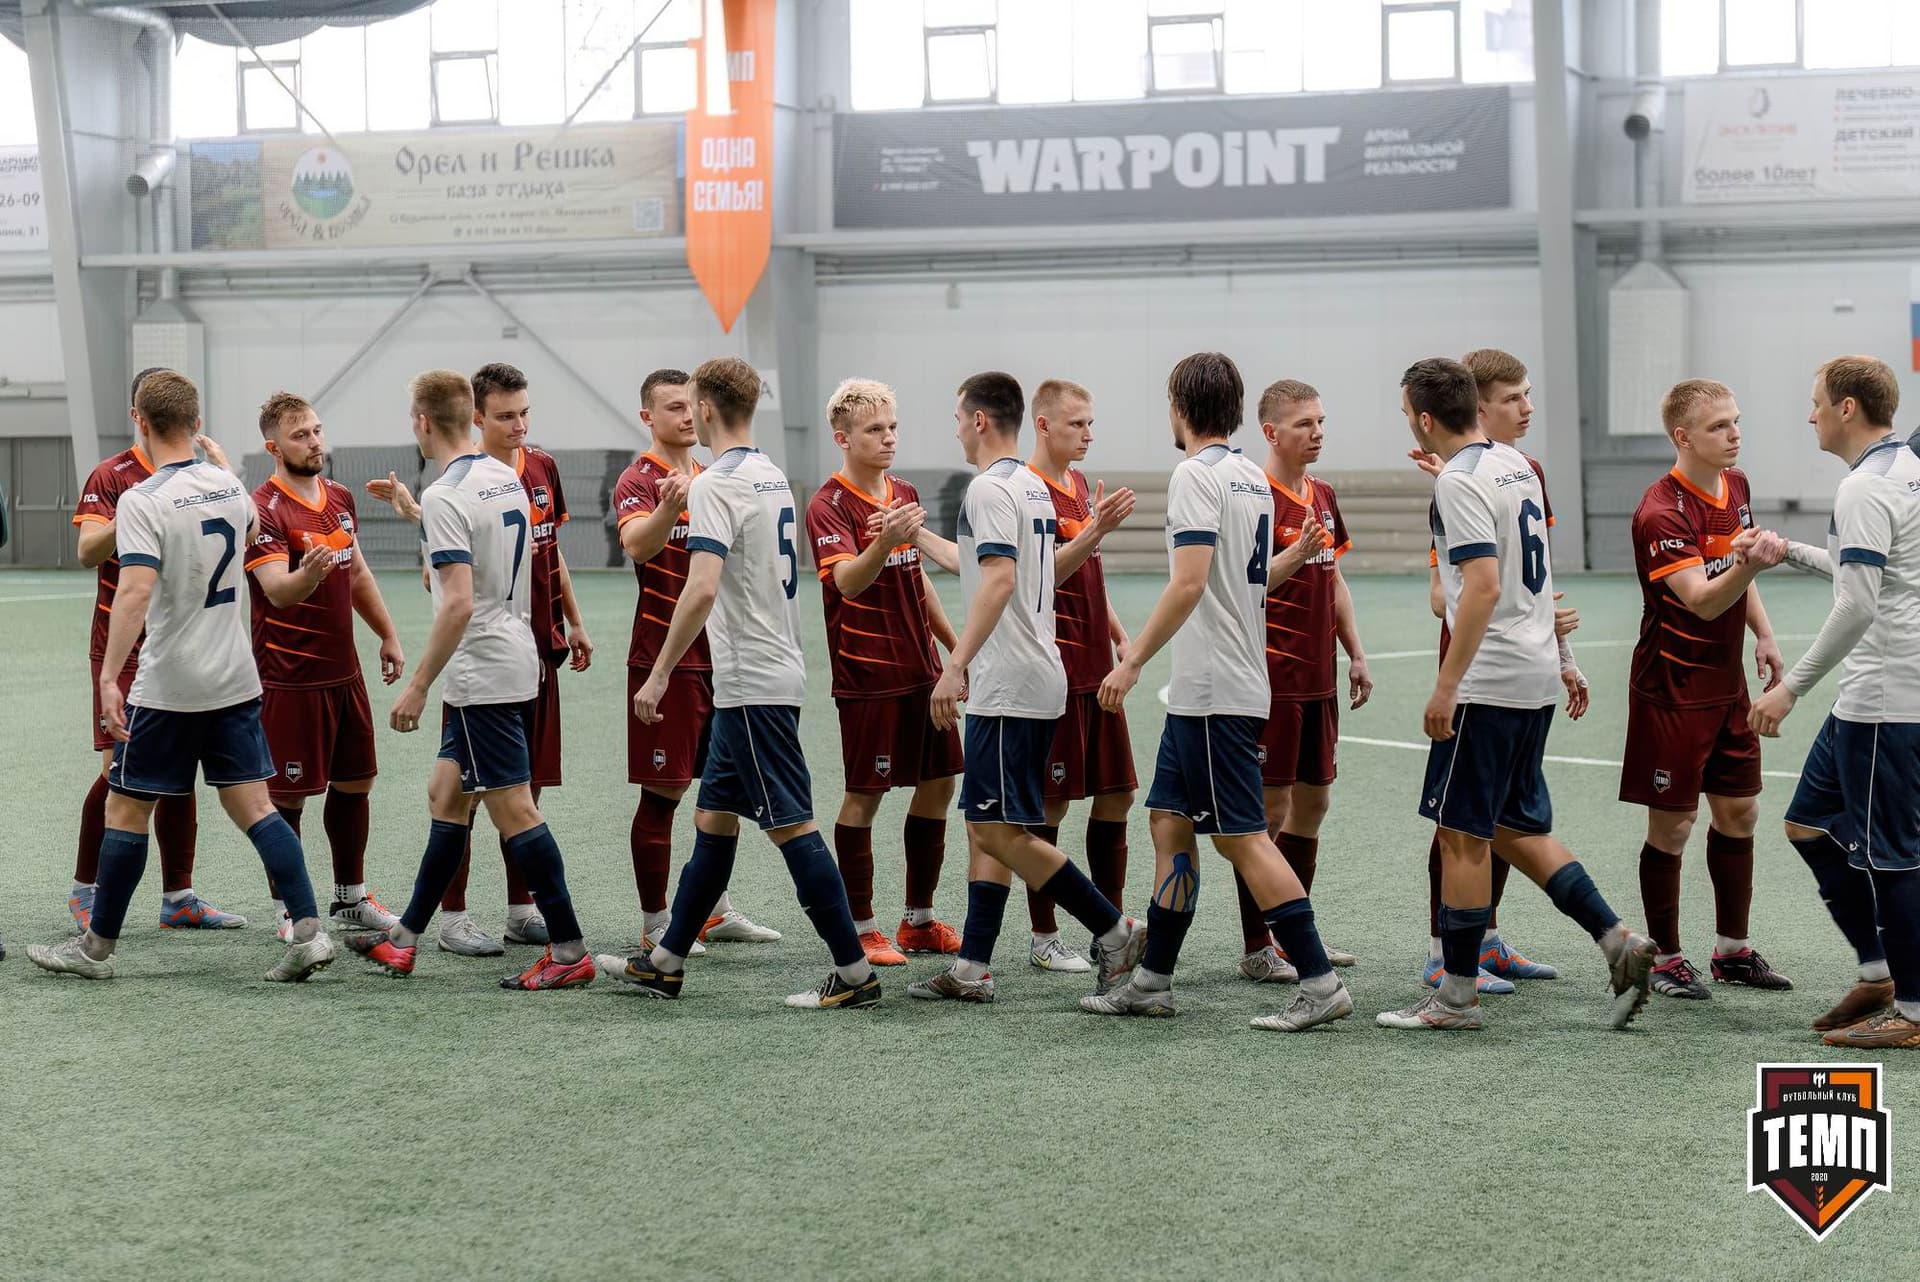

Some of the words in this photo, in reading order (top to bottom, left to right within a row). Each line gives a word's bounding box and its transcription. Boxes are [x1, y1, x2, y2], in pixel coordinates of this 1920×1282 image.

[702, 137, 756, 173] ОДНА
[1695, 166, 1756, 183] более
[693, 180, 764, 211] СЕМЬЯ!
[201, 517, 236, 608] 2
[502, 509, 527, 601] 7
[777, 506, 798, 600] 5
[817, 534, 841, 547] ПСБ
[1246, 514, 1269, 609] 4
[1518, 498, 1547, 596] 6
[1660, 538, 1685, 551] ПСБ
